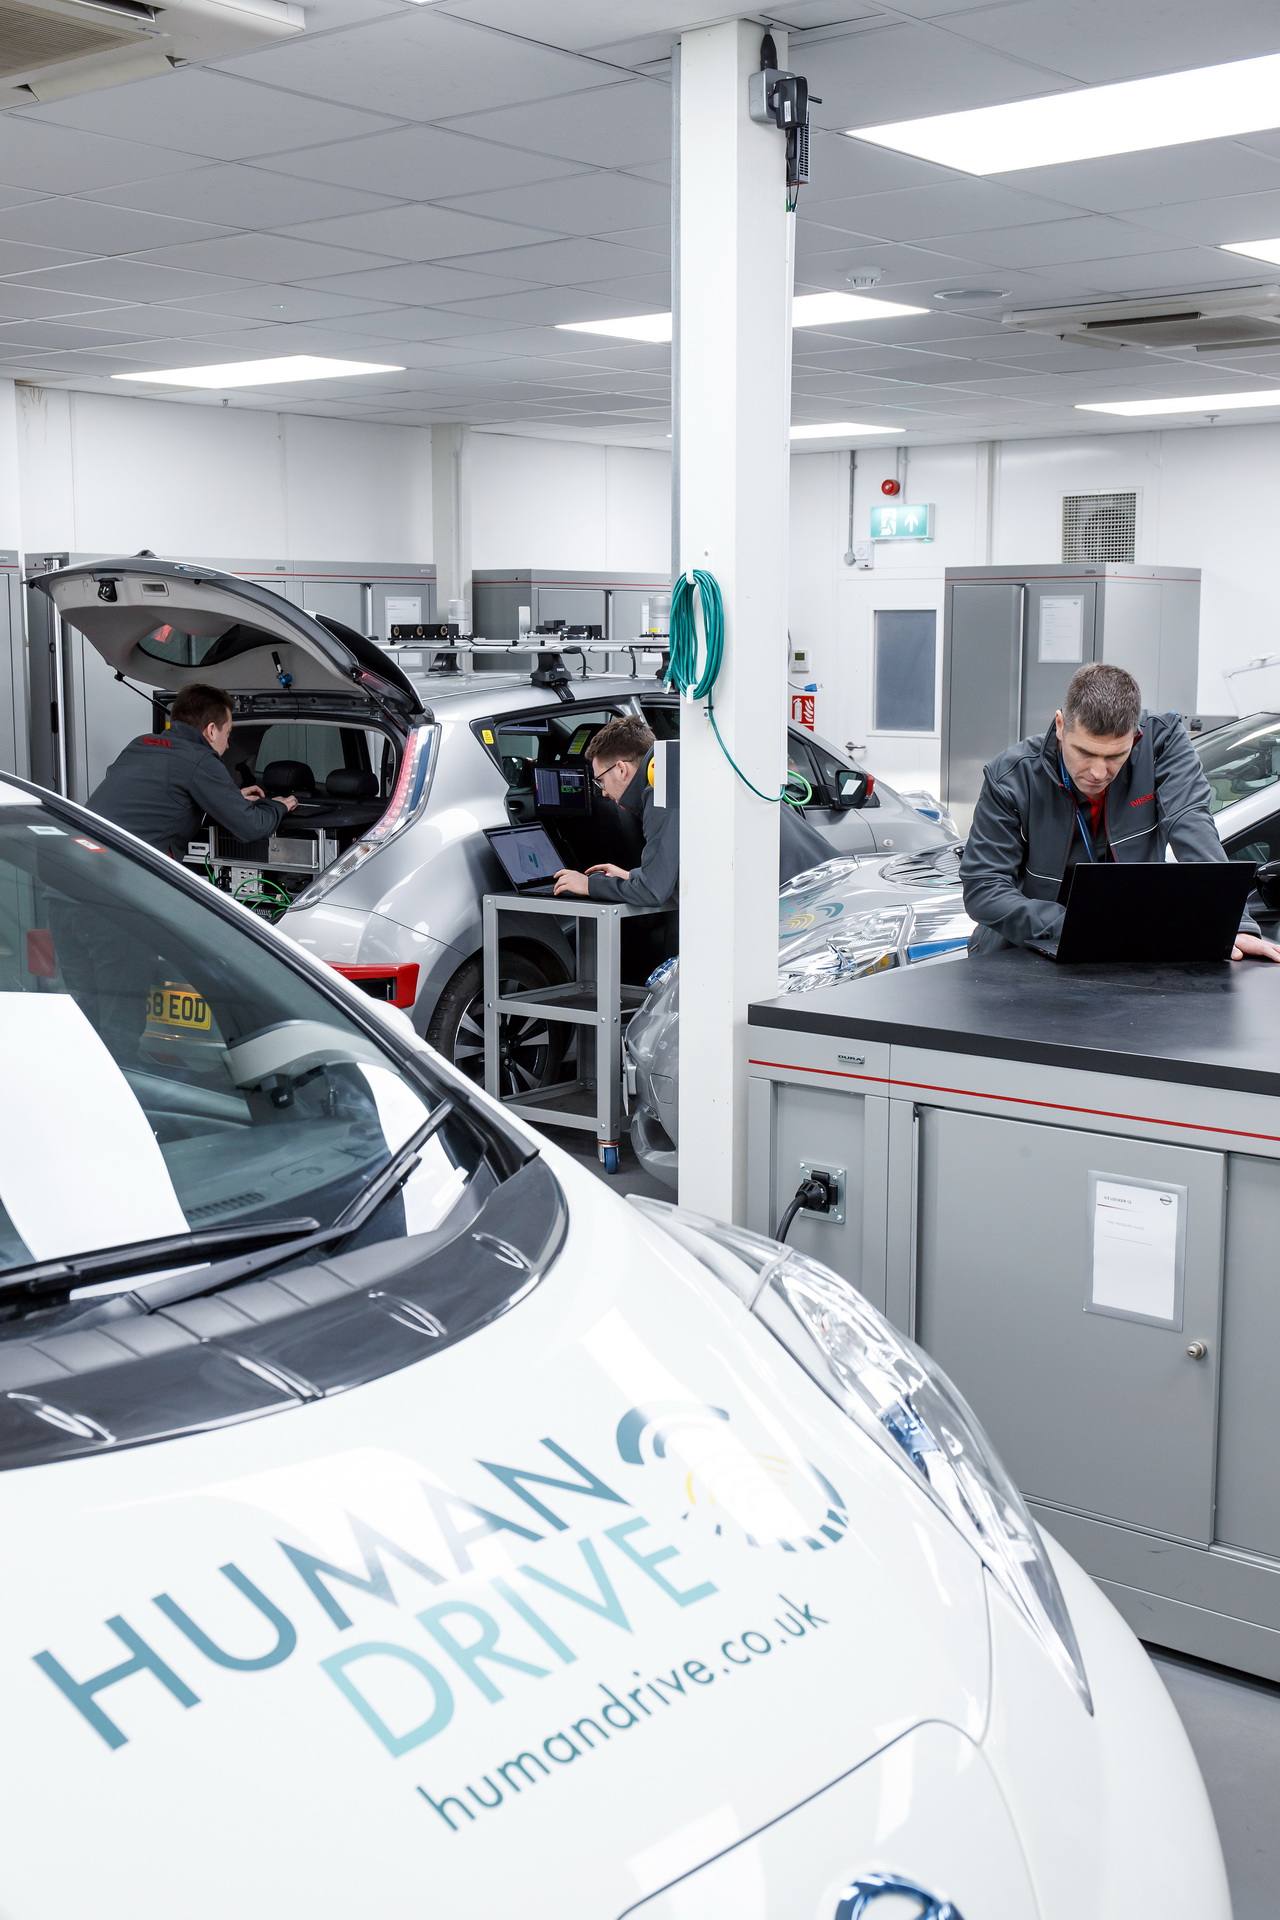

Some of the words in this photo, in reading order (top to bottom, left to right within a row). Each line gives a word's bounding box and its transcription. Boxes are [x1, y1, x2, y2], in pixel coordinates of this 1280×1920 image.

[1130, 792, 1156, 807] NISS
[169, 993, 206, 1023] EOD
[32, 1437, 634, 1752] HUMAN
[318, 1516, 719, 1759] DRIVE
[415, 1594, 830, 1833] humandrive.co.uk
